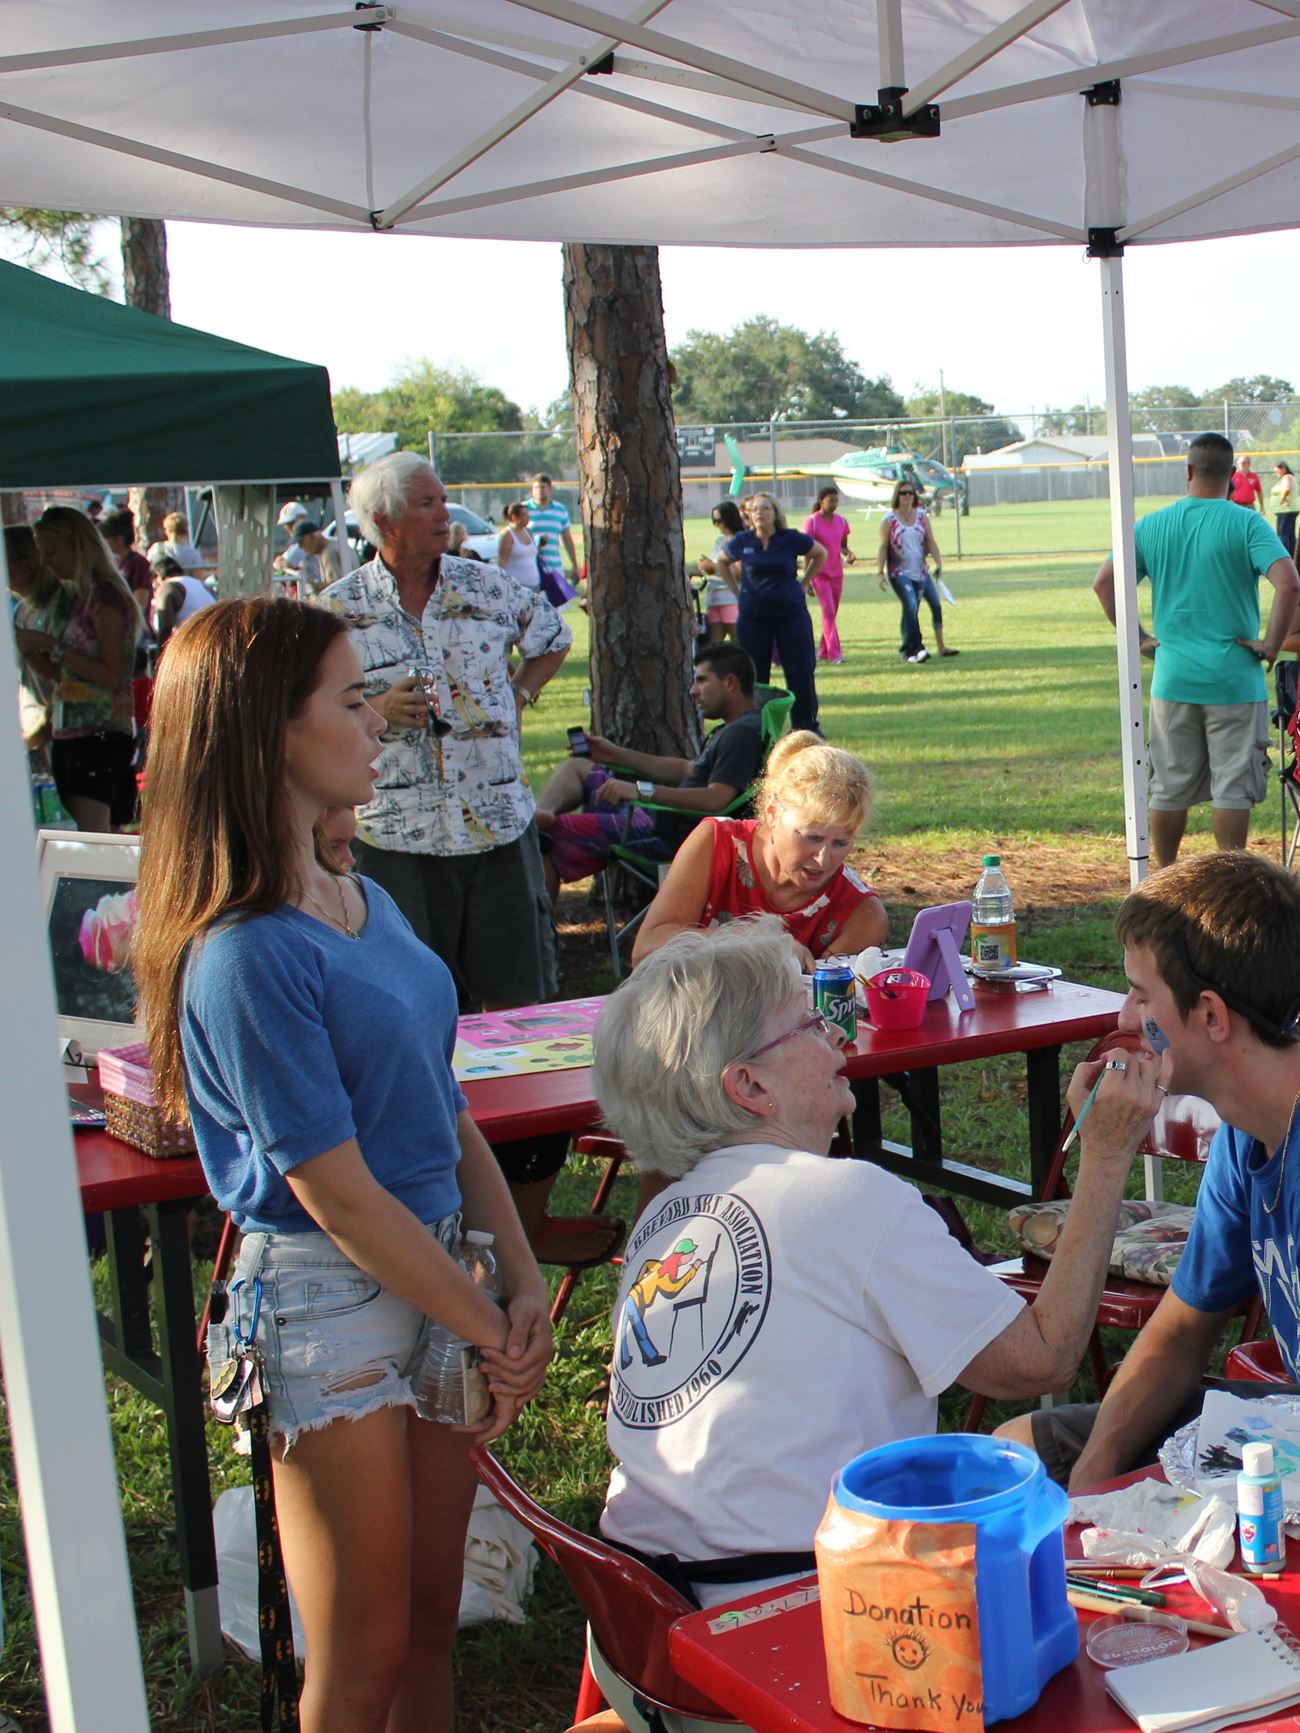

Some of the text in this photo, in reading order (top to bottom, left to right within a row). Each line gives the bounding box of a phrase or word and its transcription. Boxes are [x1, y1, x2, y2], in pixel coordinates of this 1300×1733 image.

[634, 1194, 764, 1296] BREVARD ART ASSOCIATION
[615, 1359, 722, 1424] ESTABLISHED 1960
[843, 1587, 972, 1630] Donation
[855, 1671, 942, 1711] Thank
